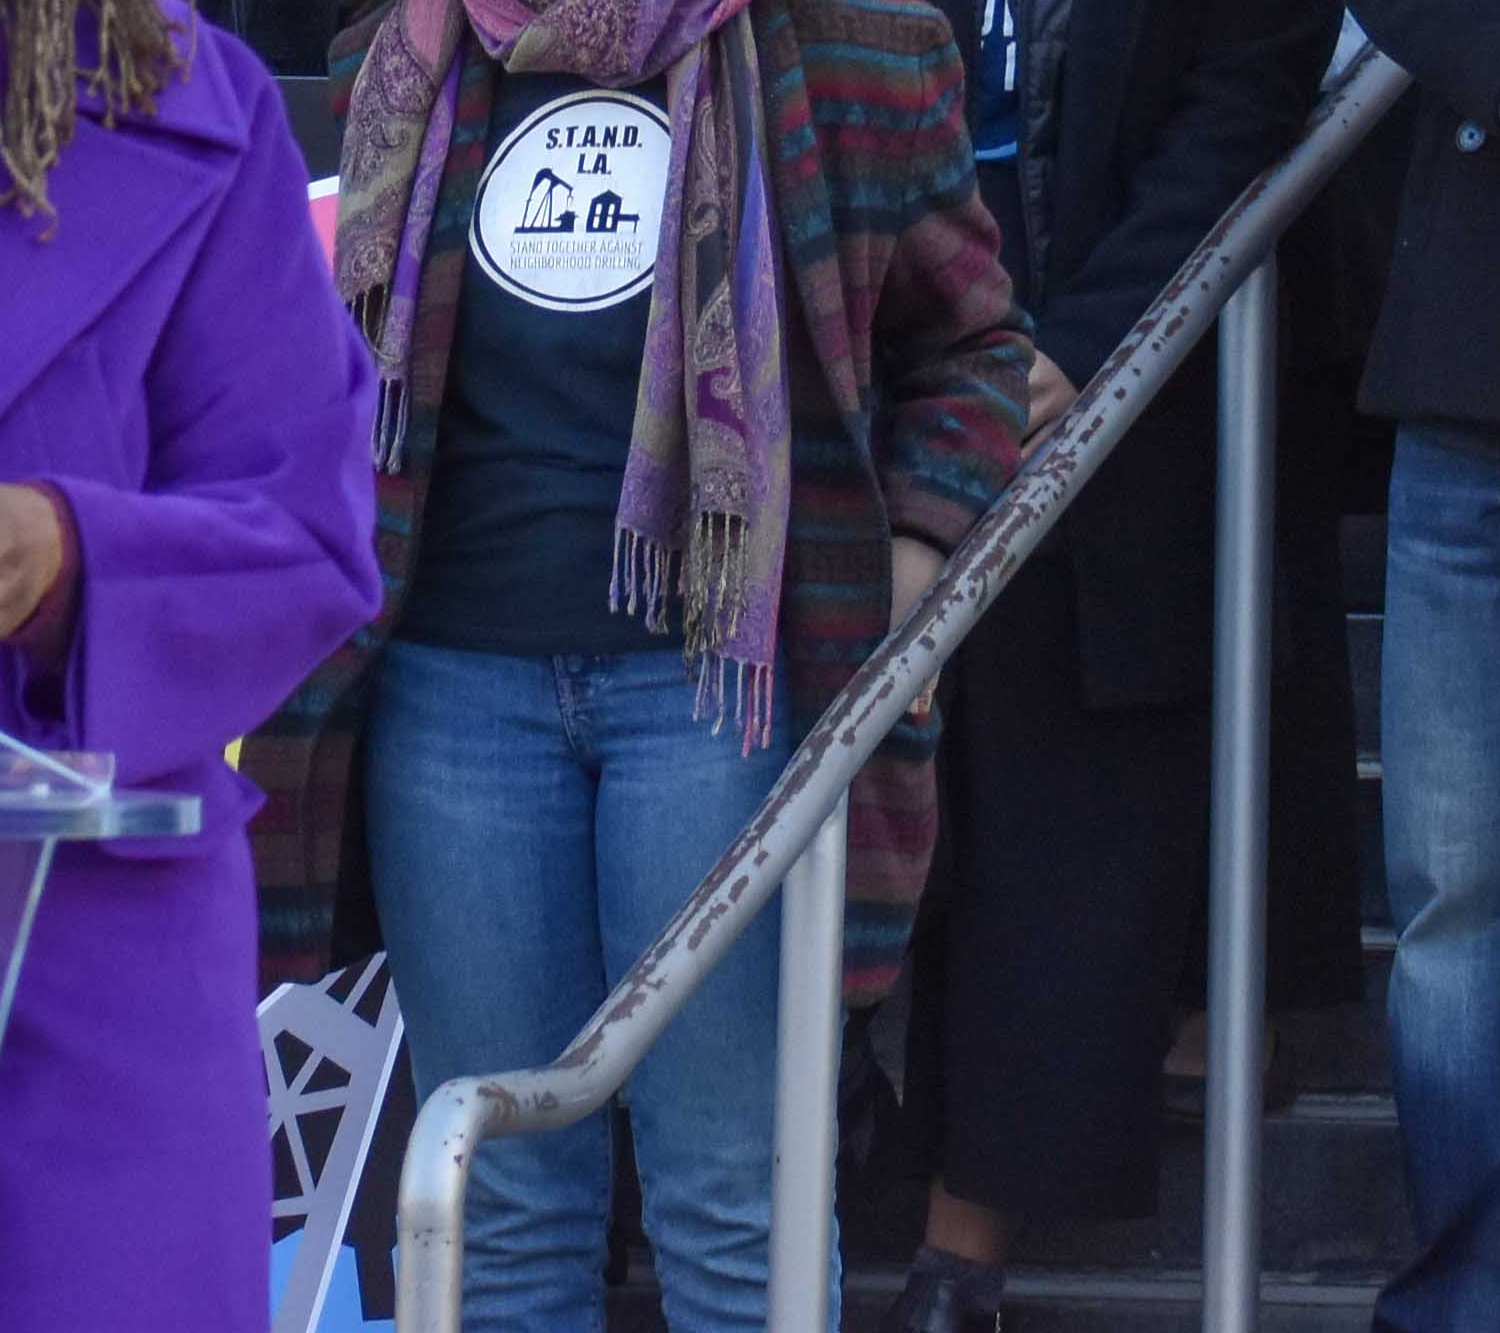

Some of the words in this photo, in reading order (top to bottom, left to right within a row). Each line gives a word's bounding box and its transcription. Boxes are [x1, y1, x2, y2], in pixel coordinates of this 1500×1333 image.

[545, 125, 643, 150] S.T.A.N.D.
[577, 152, 612, 175] L.A.
[510, 240, 543, 255] STAND
[546, 239, 597, 255] TOGETHER
[599, 239, 643, 255] AGAINST
[510, 254, 592, 270] NEIGHBORHOOD
